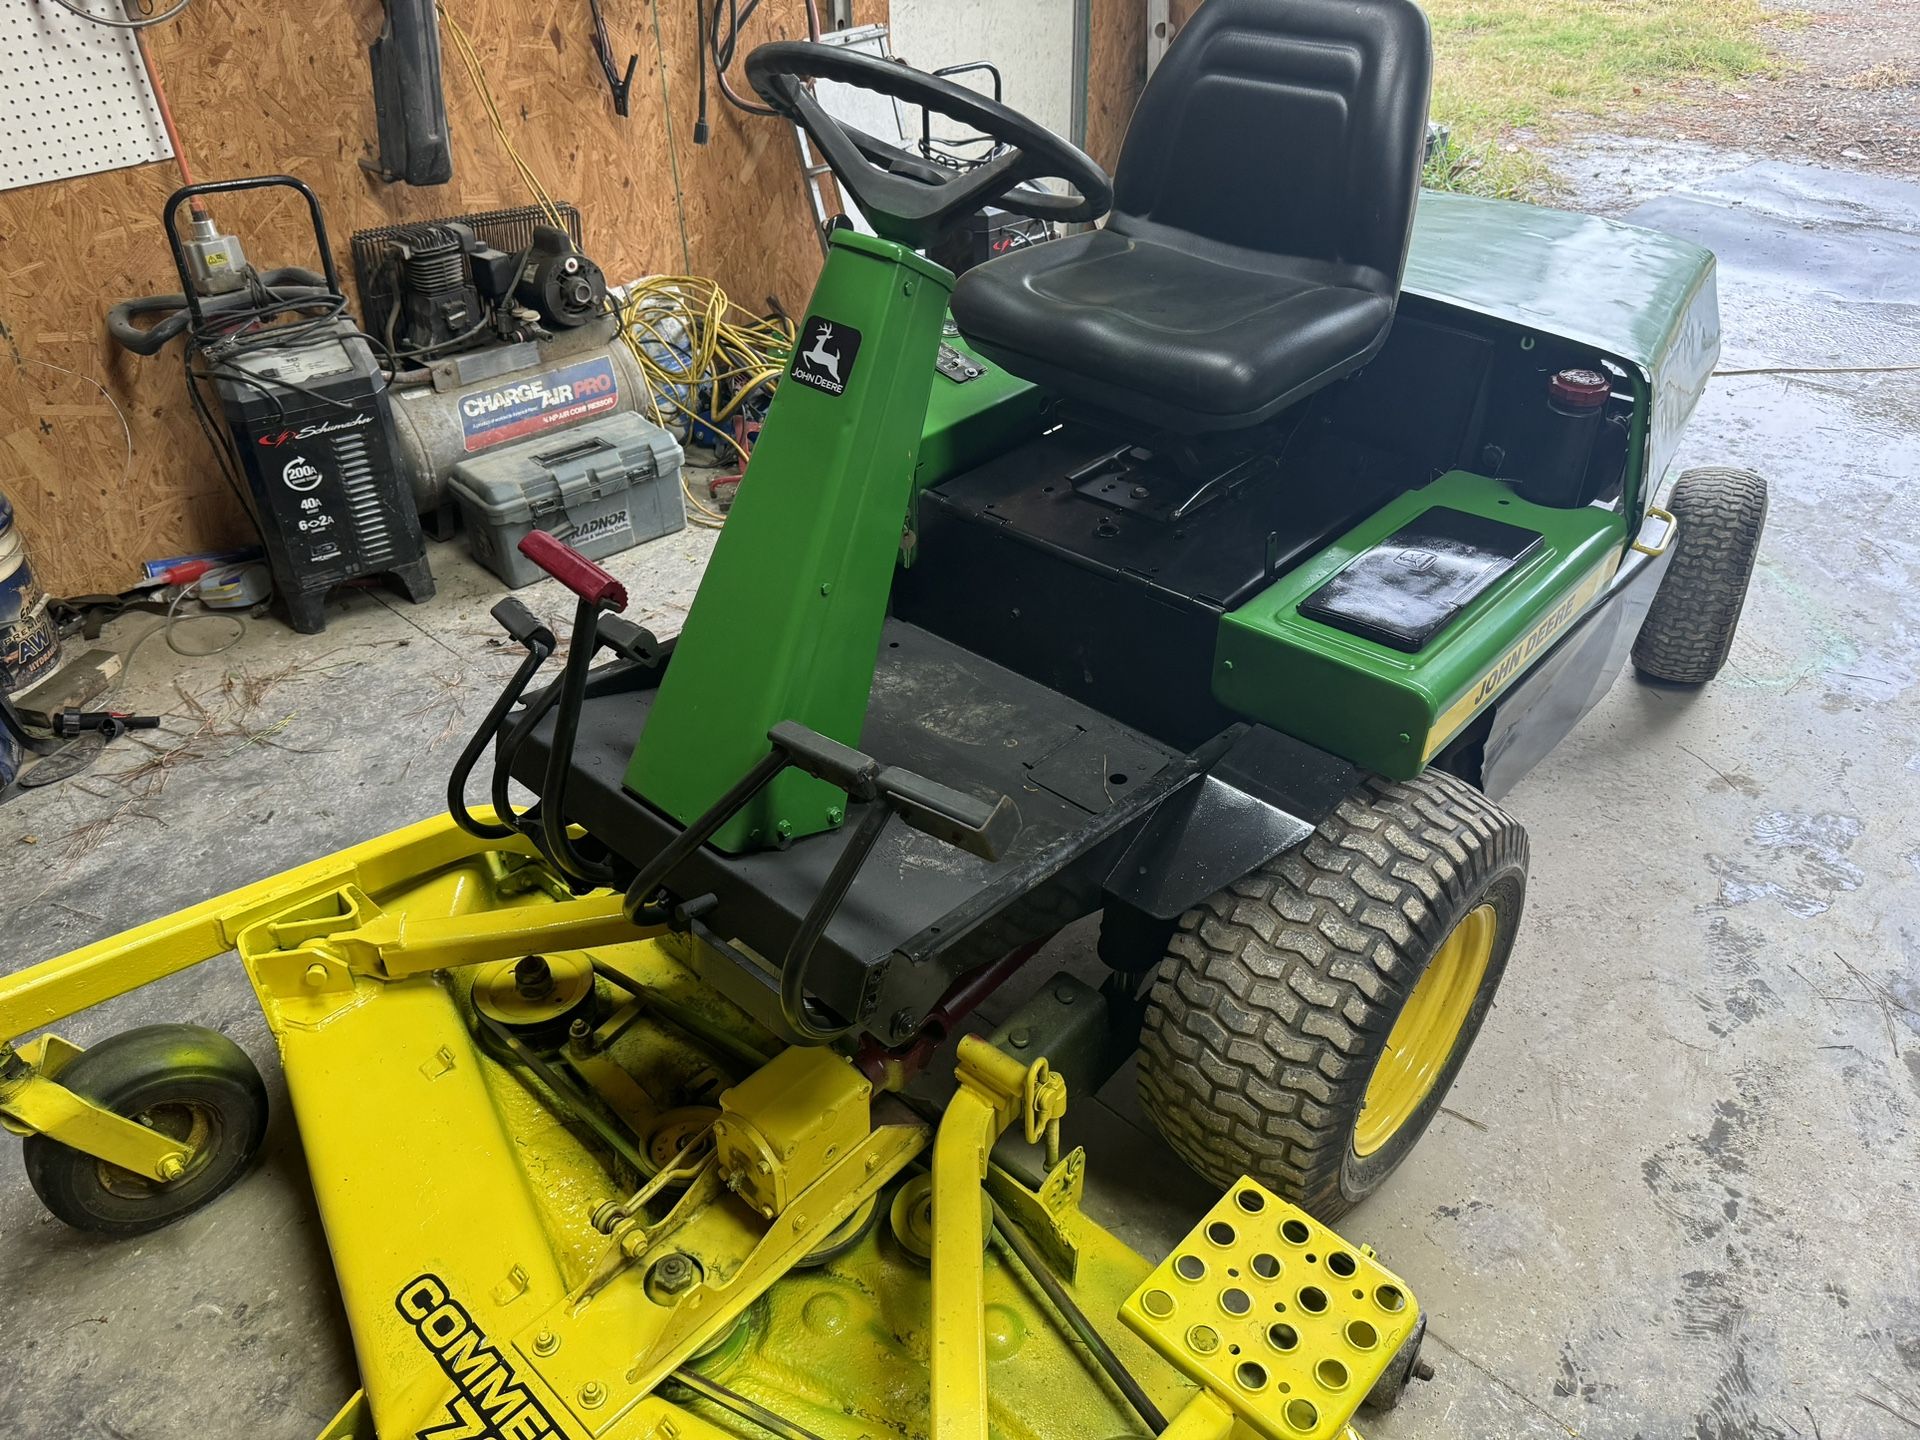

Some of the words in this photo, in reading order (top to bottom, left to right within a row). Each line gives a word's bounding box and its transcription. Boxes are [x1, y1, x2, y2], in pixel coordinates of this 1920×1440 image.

[463, 381, 543, 416] CHARGE
[541, 385, 574, 408] AIR
[572, 373, 612, 399] PRO
[792, 367, 815, 383] JOHN
[815, 375, 843, 394] DEERE
[295, 413, 374, 439] Schumacher
[288, 465, 318, 480] 200A
[300, 497, 323, 510] 40A
[570, 511, 628, 539] RADNOR
[18, 622, 50, 665] AW
[1474, 646, 1523, 705] JOHN
[1524, 594, 1576, 658] DEERE
[395, 1273, 572, 1440] COMME
[415, 1396, 506, 1440] 7
